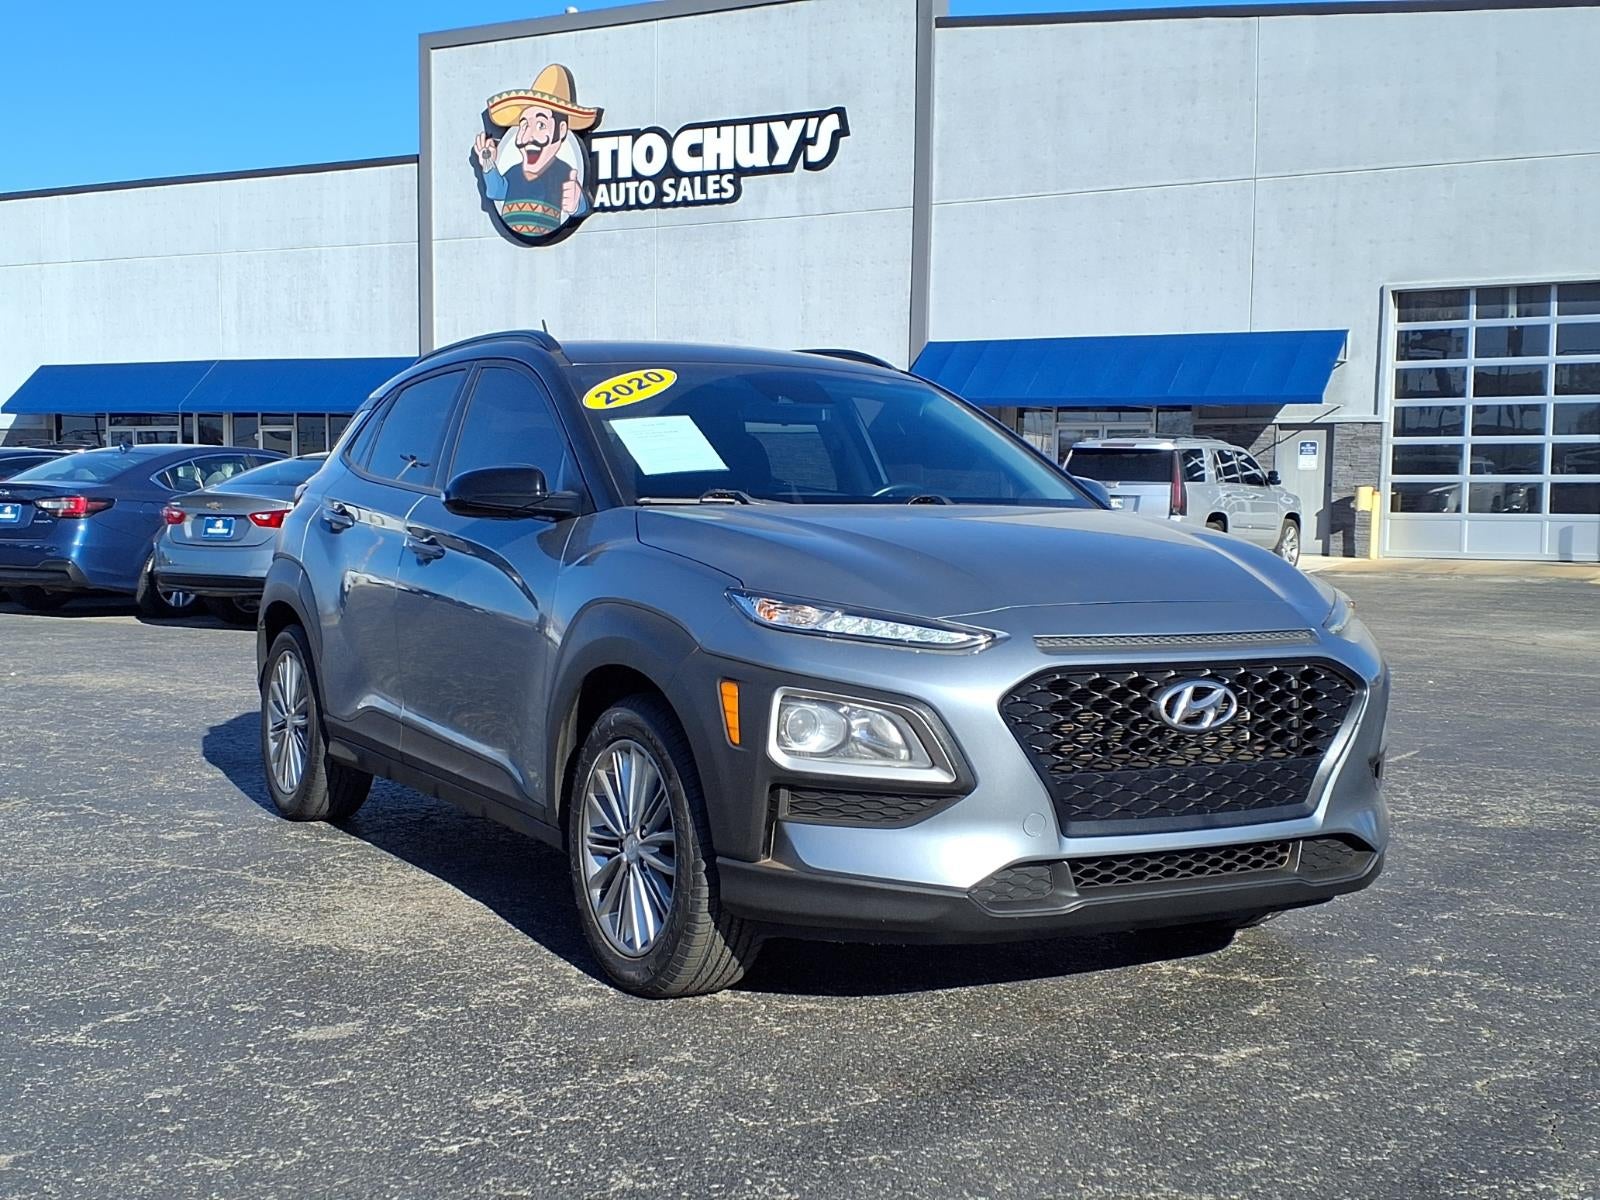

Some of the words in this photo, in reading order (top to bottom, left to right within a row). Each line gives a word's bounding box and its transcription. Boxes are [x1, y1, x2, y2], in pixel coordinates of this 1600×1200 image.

[591, 132, 668, 179] TIO
[672, 113, 840, 173] CHUY'S
[593, 180, 656, 208] AUTO
[662, 173, 735, 203] SALES
[595, 371, 665, 405] 2020
